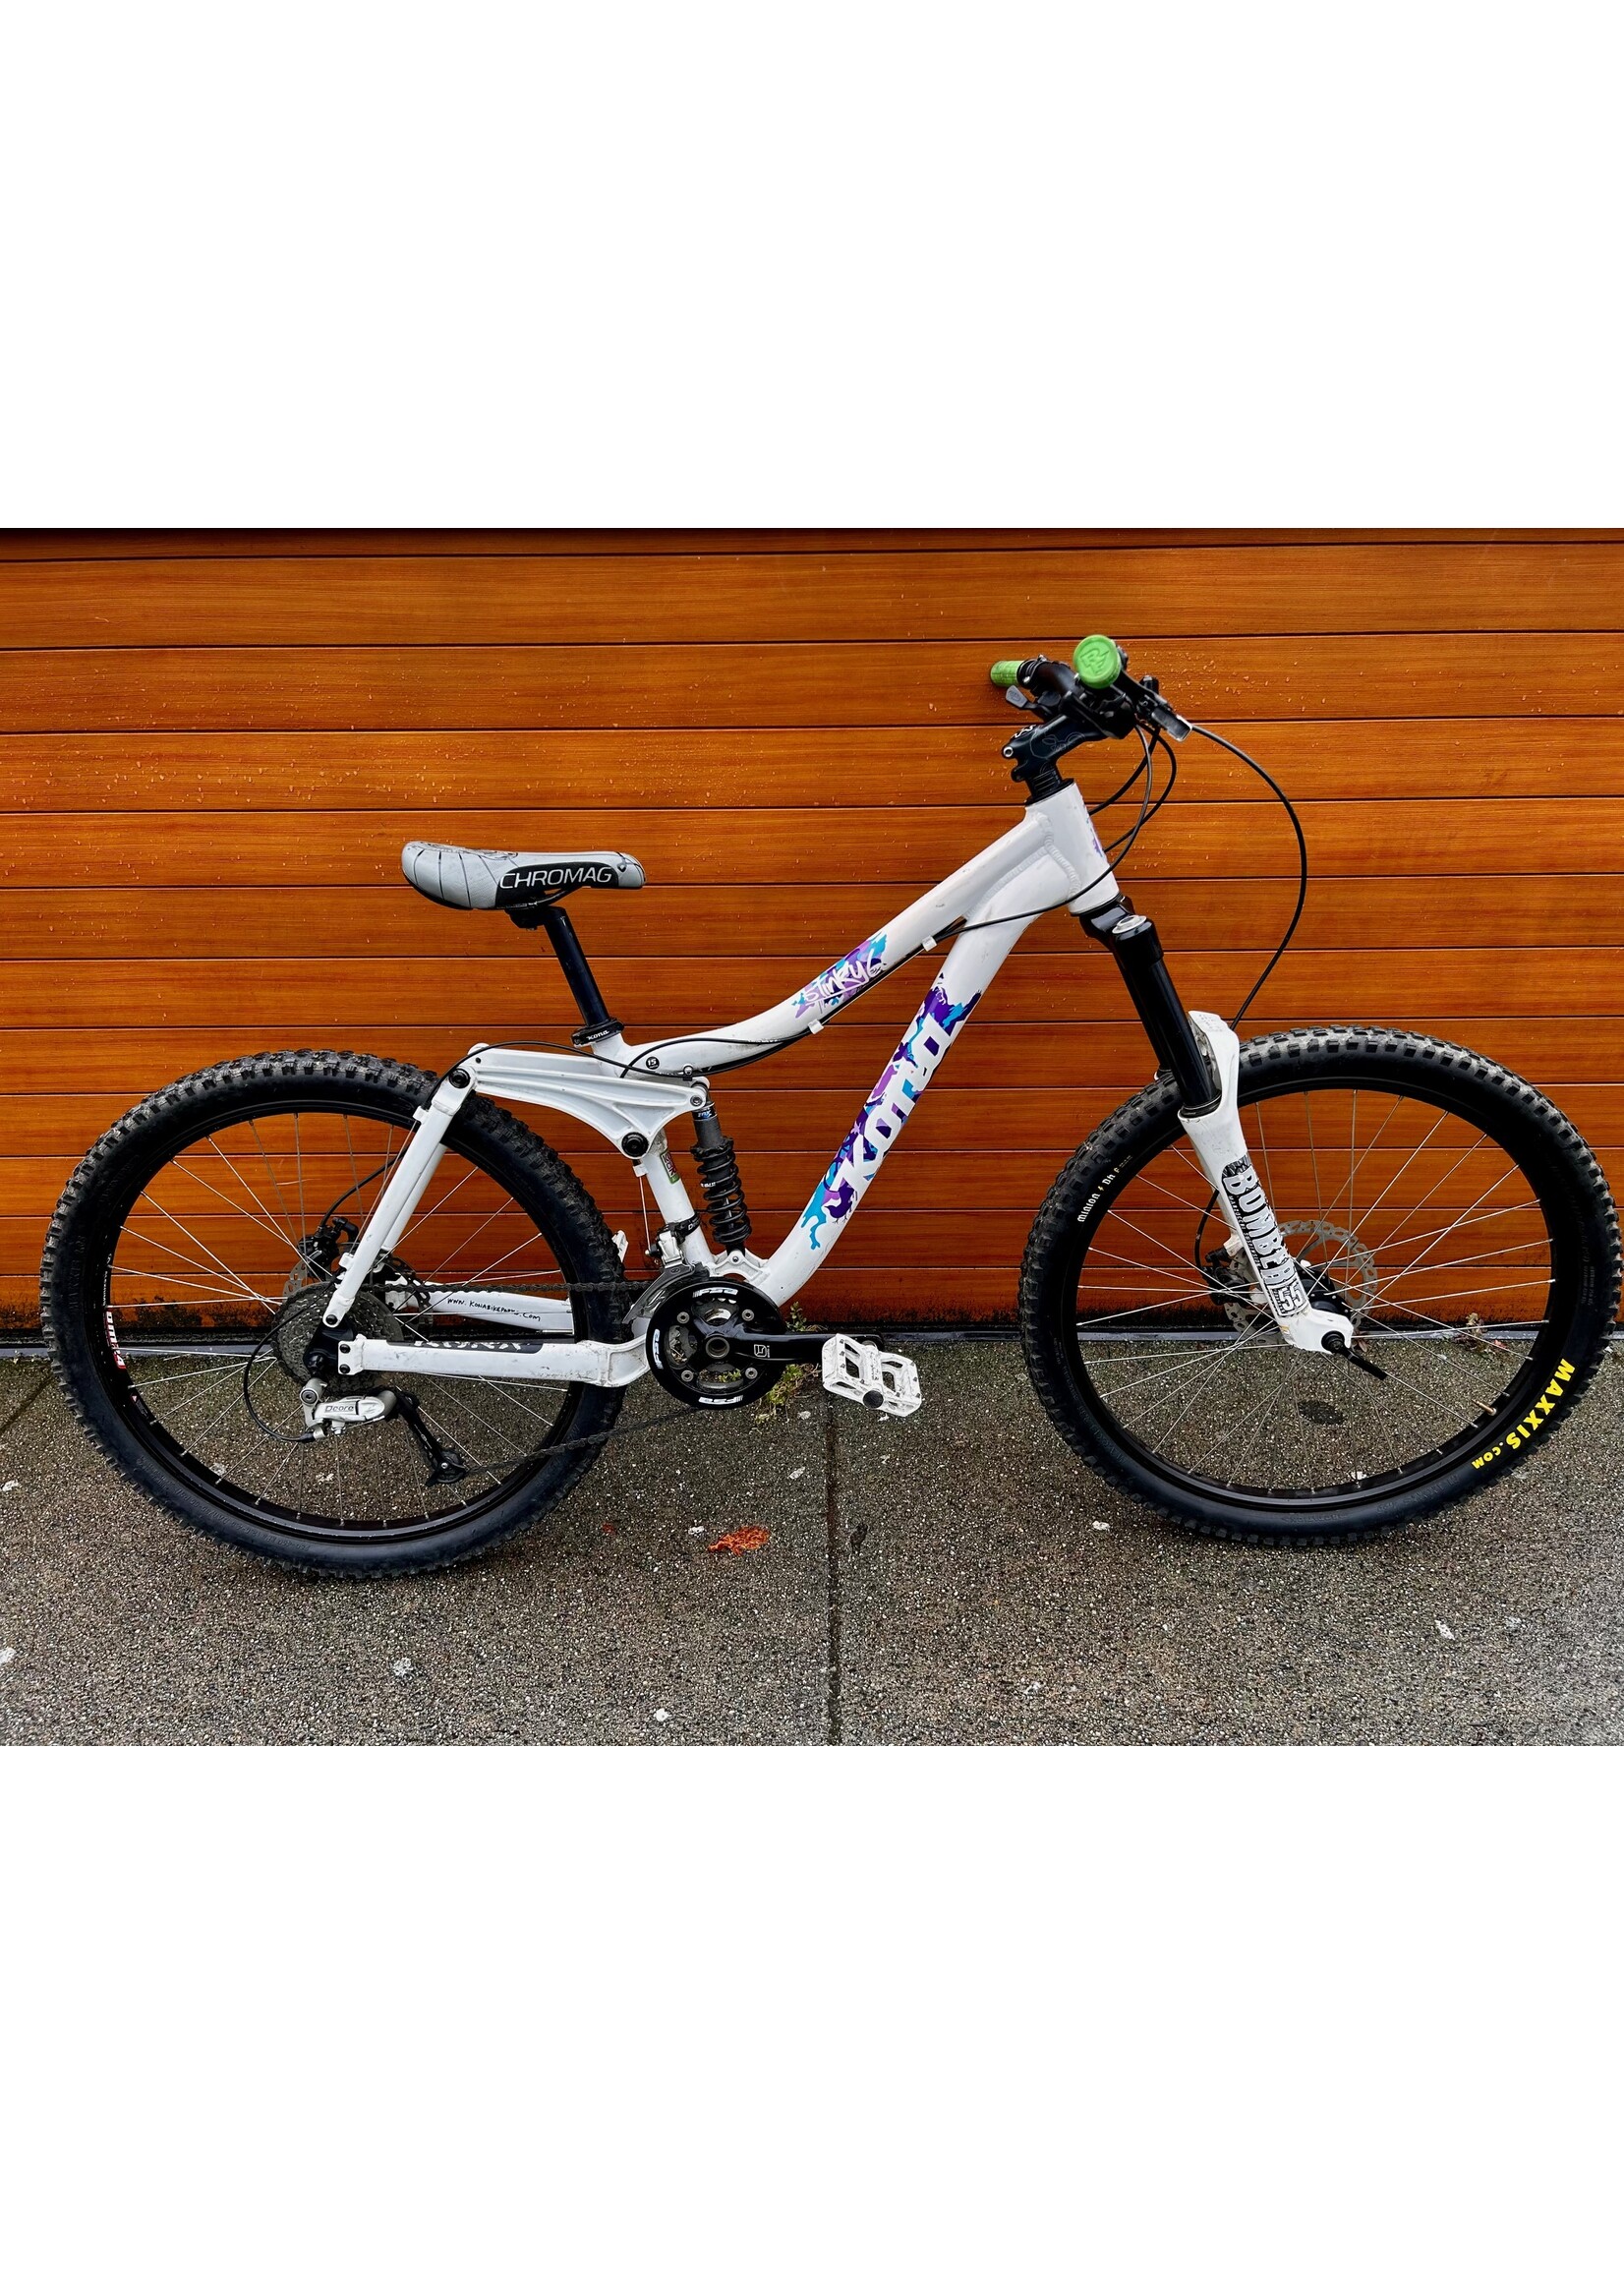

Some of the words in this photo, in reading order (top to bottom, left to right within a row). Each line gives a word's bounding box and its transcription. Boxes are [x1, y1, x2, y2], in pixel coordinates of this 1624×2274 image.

[499, 866, 612, 889] CHROMAG
[1278, 1281, 1304, 1312] 55
[1471, 1358, 1576, 1470] MAXXIS.COM
